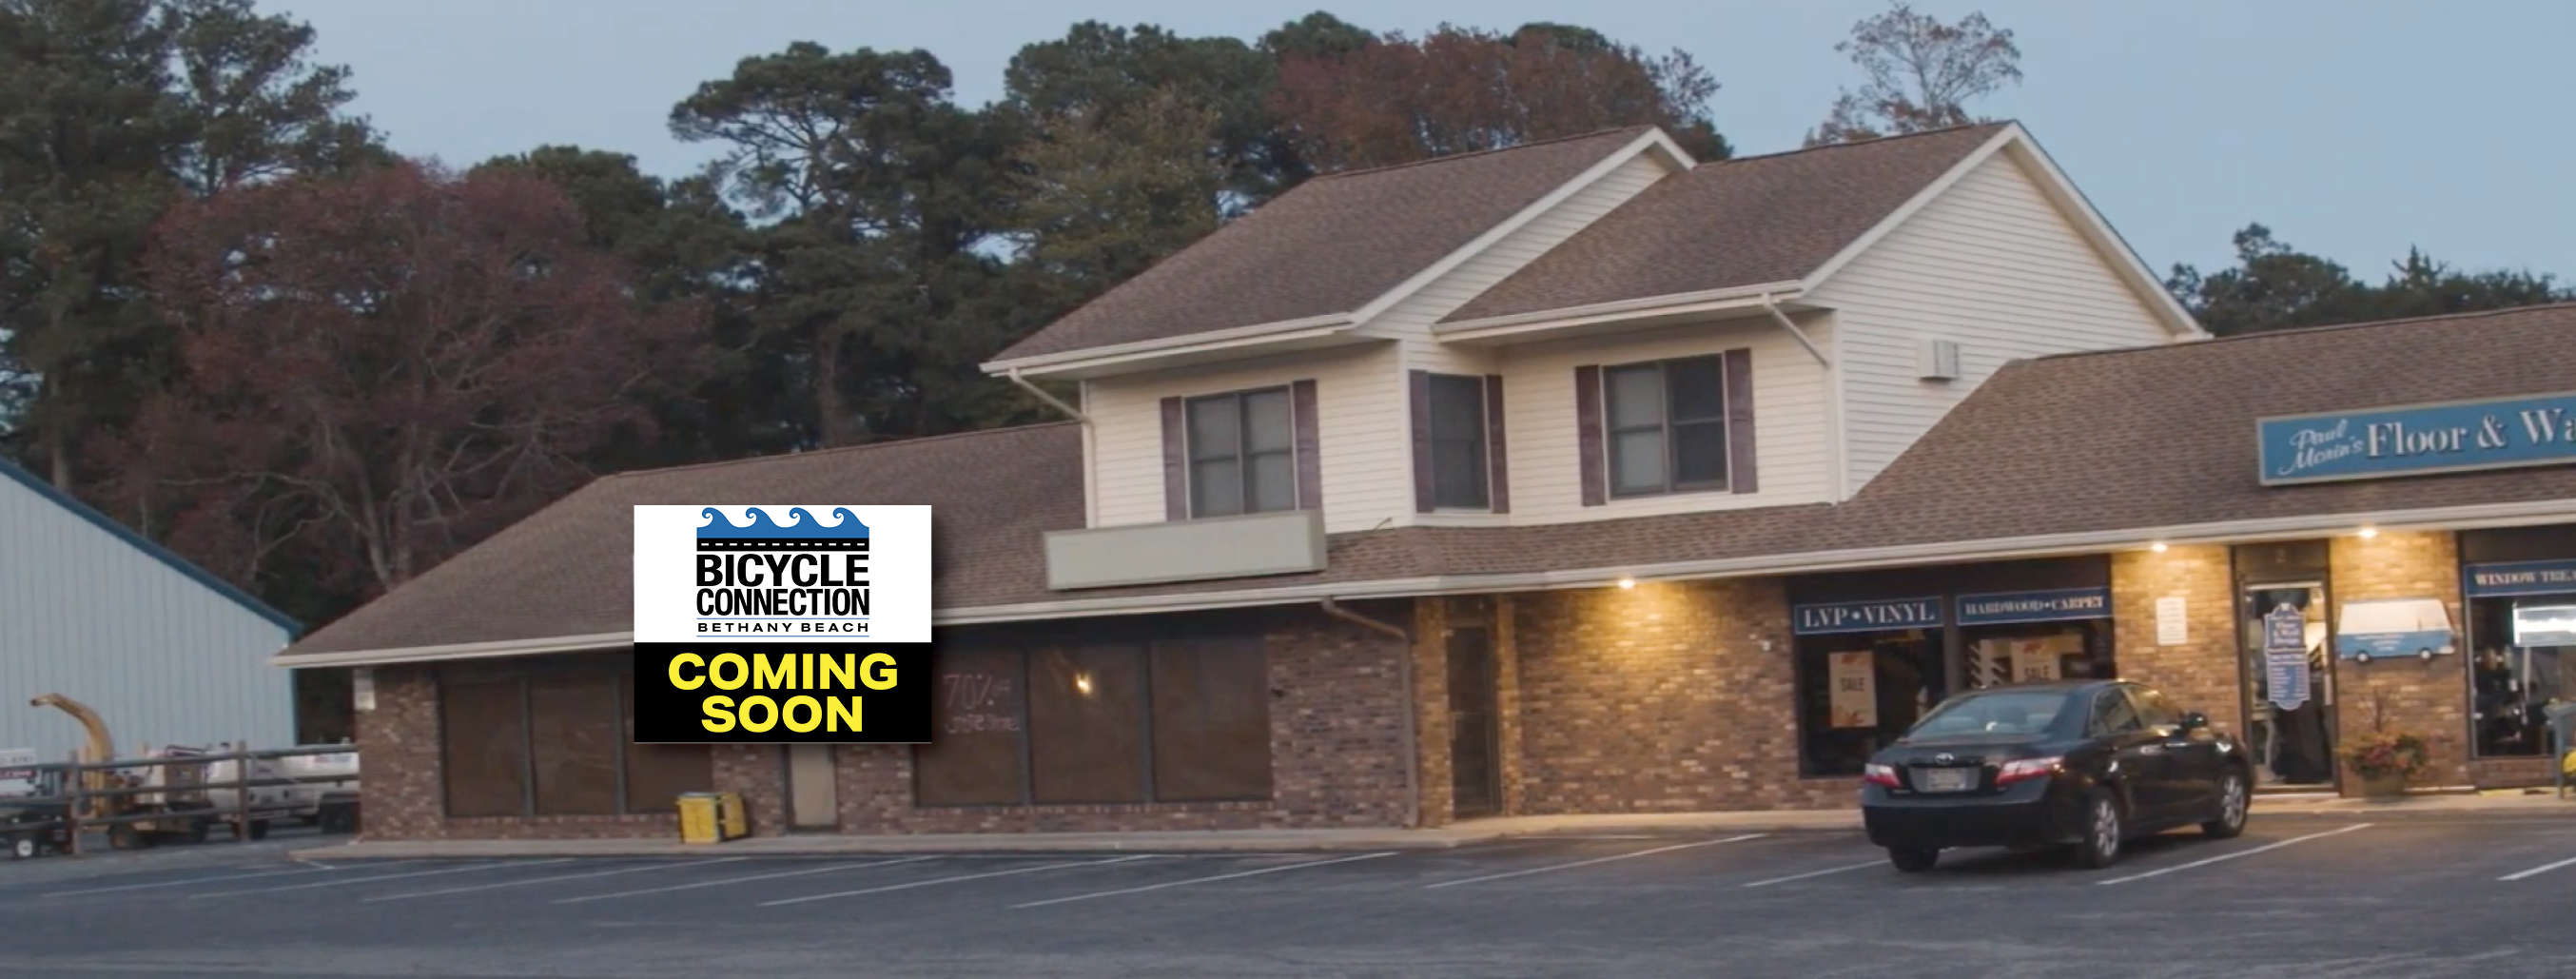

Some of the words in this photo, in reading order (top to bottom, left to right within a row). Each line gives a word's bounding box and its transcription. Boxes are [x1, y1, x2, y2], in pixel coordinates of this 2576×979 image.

[2289, 419, 2349, 450] Paul
[2367, 421, 2468, 457] Floor
[2477, 415, 2506, 448] &
[2475, 572, 2535, 585] WINDOW
